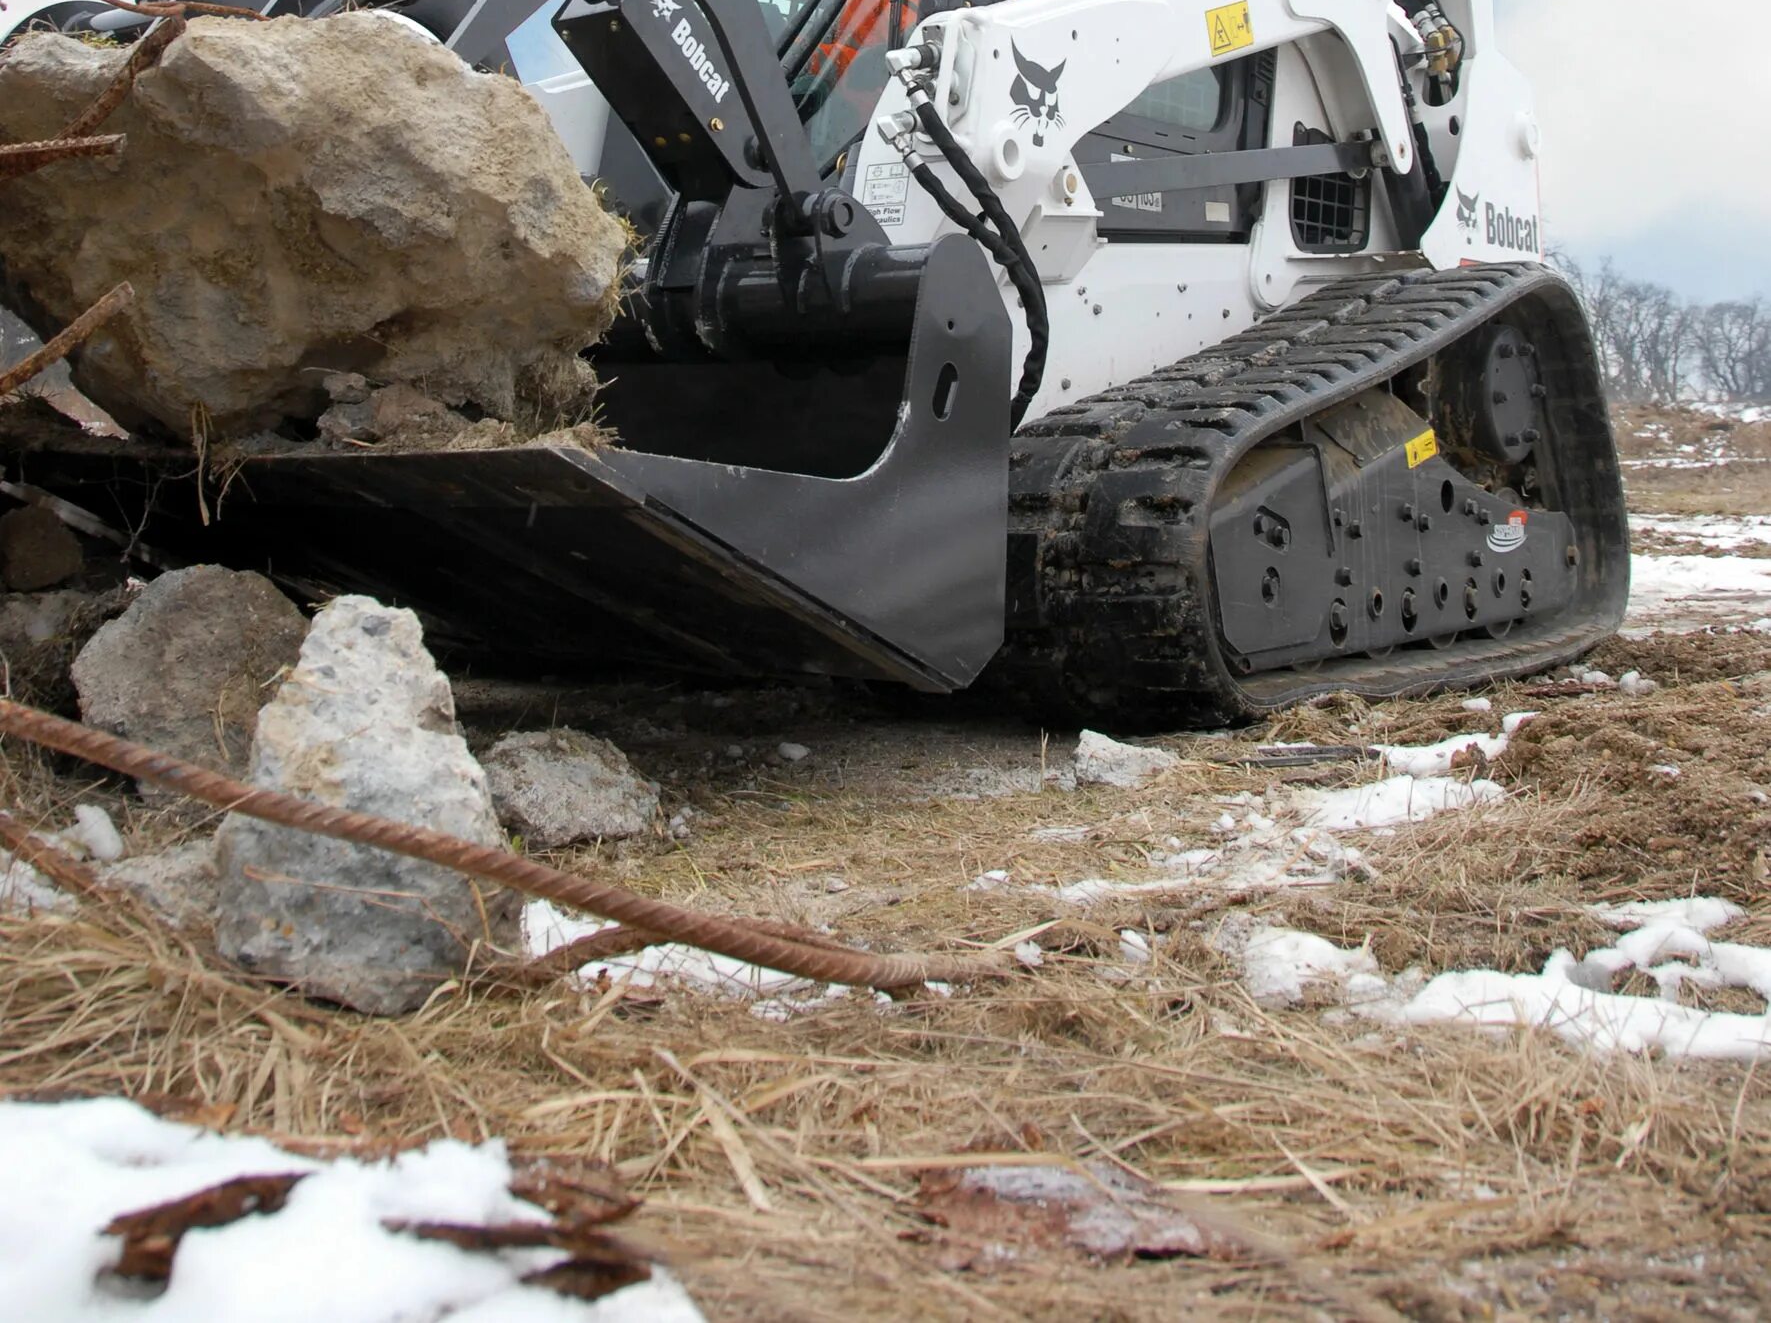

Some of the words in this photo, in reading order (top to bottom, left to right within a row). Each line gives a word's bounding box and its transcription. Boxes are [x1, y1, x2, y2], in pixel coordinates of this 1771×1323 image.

[671, 18, 730, 104] Bobcat
[883, 207, 901, 215] Flow
[1485, 201, 1539, 254] Bobcat
